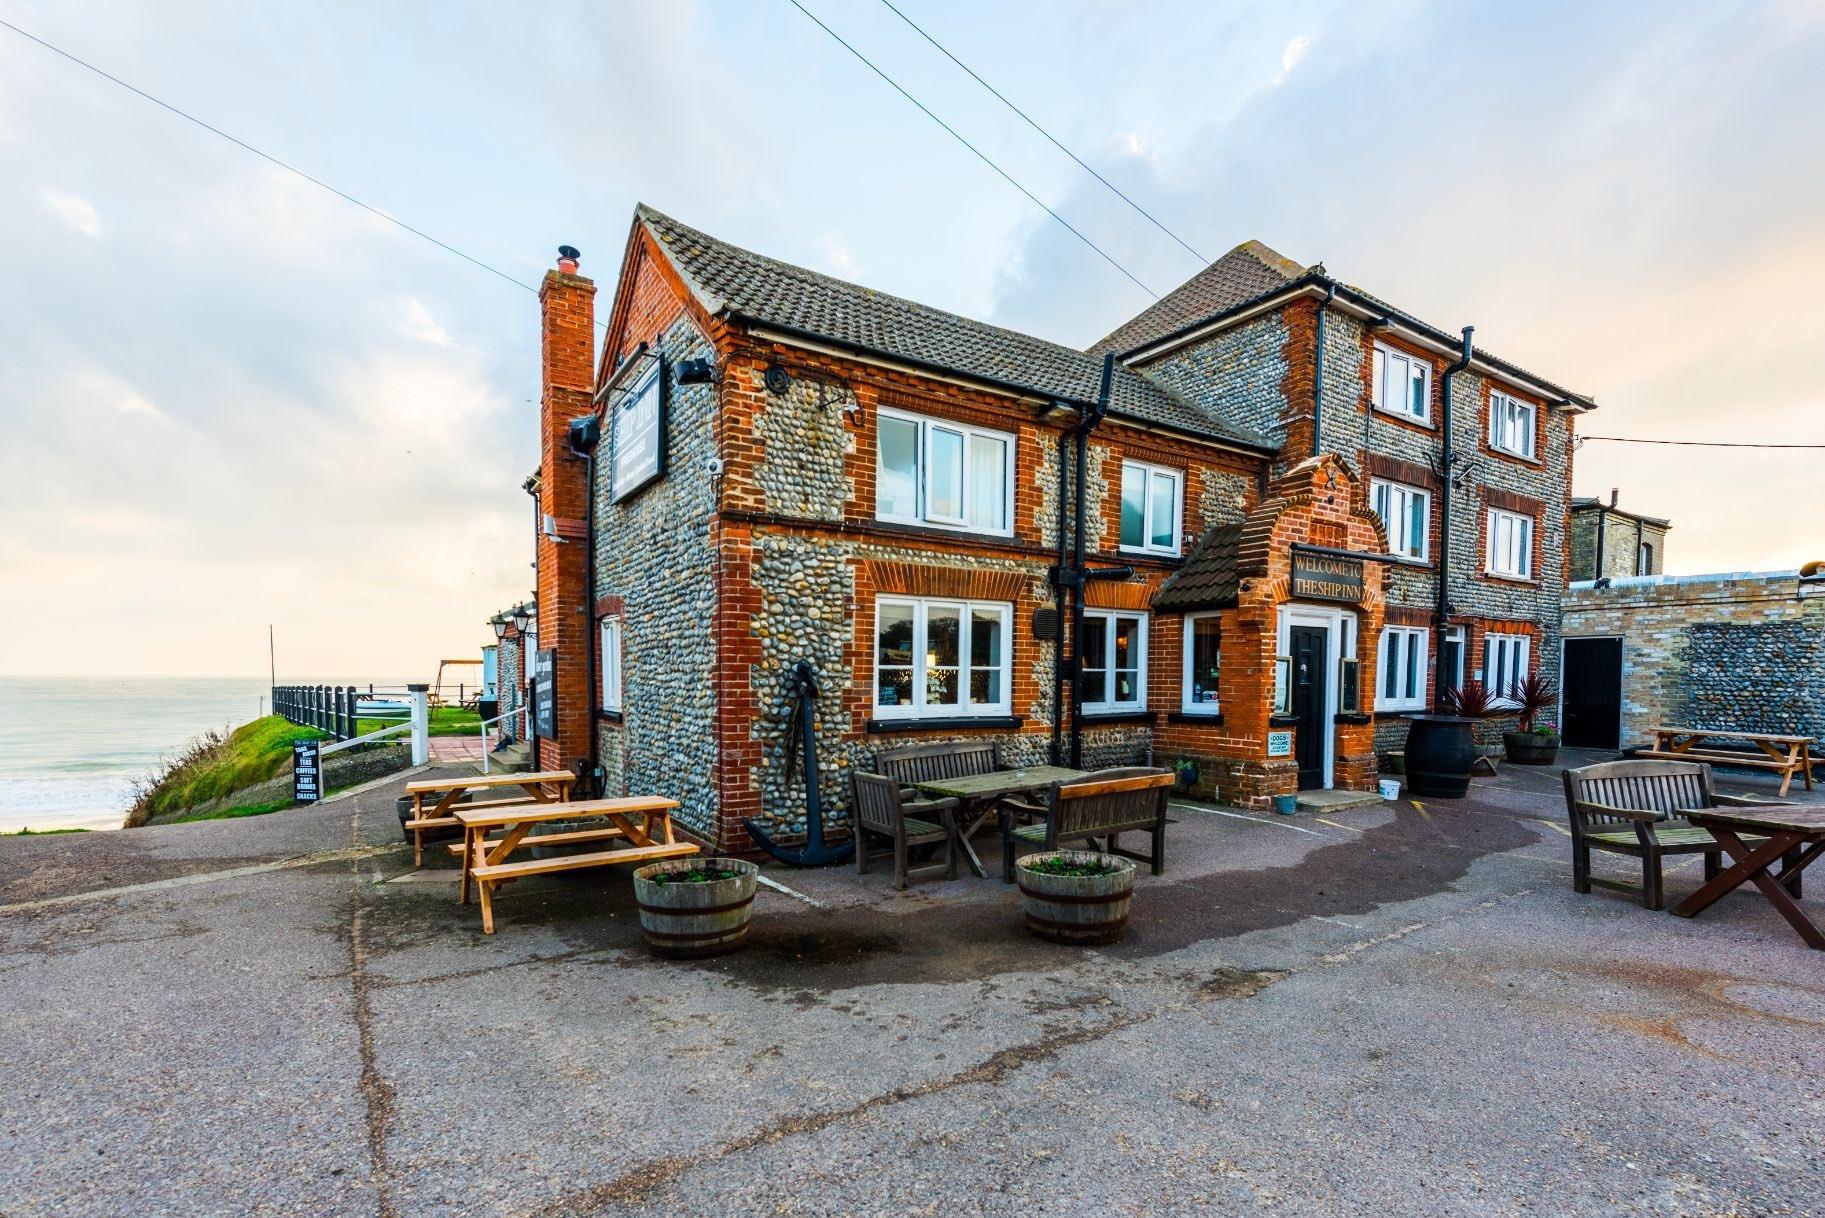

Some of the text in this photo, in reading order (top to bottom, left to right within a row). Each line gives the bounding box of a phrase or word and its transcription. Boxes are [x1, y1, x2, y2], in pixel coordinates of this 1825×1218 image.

[636, 383, 658, 430] INN
[1295, 556, 1362, 578] WELCOME TO
[1295, 578, 1361, 600] THE SHIP INN
